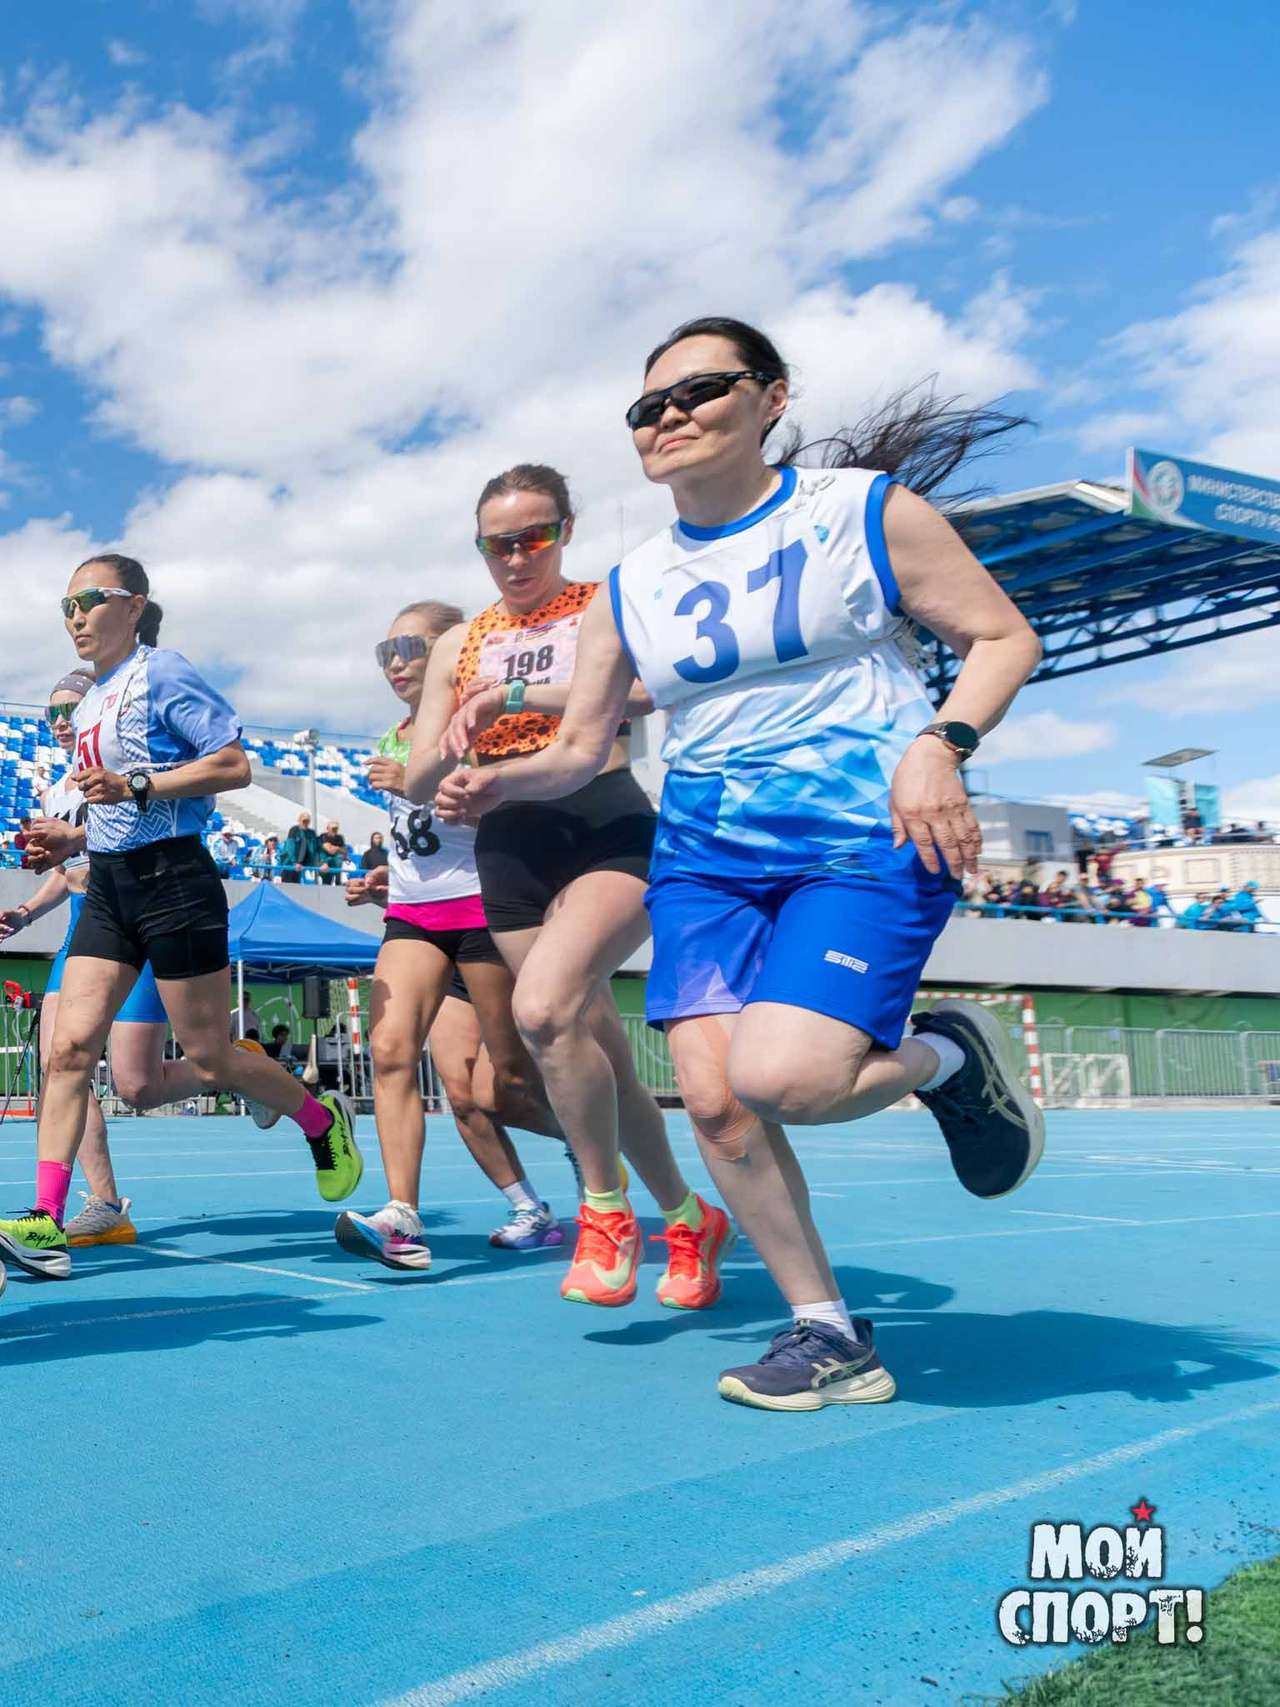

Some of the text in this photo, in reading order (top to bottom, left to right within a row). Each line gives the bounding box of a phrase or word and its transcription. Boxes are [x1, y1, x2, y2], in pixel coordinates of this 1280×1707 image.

[673, 539, 809, 684] 37
[503, 644, 554, 680] 198
[78, 720, 104, 773] 51
